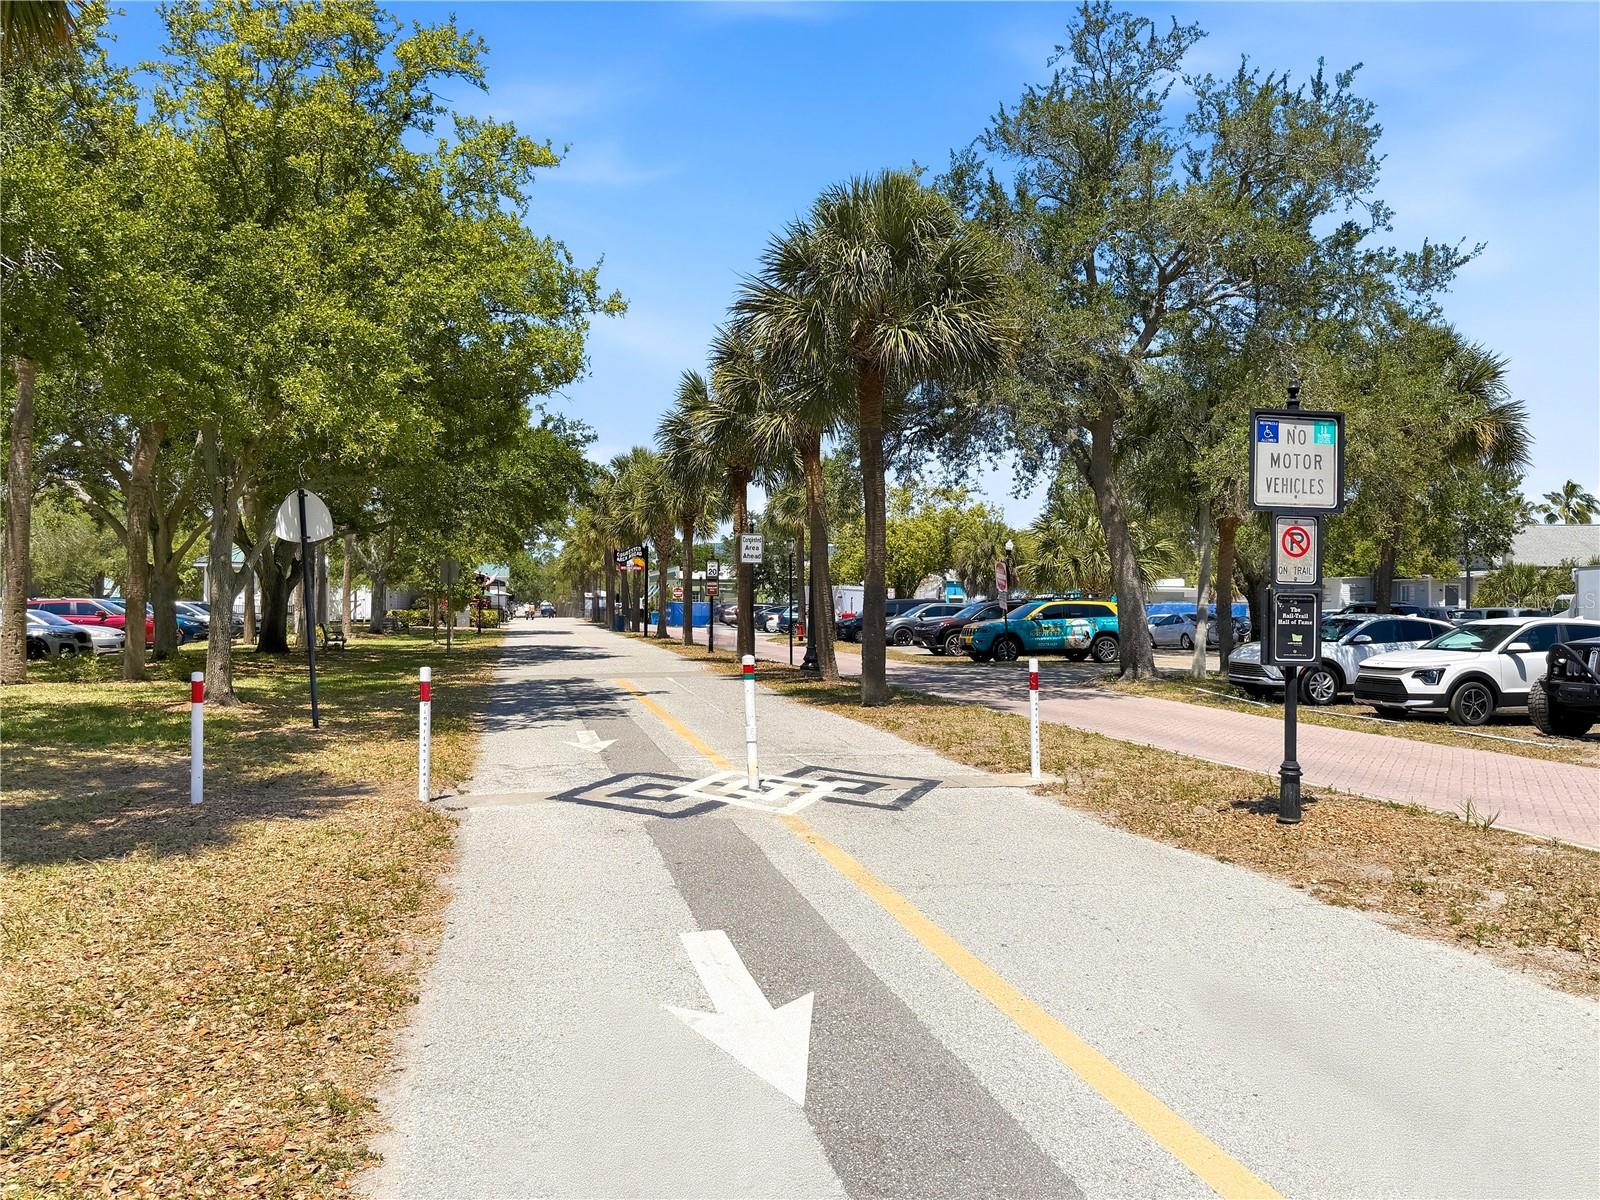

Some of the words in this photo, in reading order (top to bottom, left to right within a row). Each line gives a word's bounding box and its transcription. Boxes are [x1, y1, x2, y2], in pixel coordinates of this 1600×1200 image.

[1287, 429, 1306, 445] NO
[1270, 452, 1323, 470] MOTOR
[1266, 477, 1324, 494] VEHICLES
[708, 568, 717, 576] 20
[1278, 566, 1288, 575] ON
[1293, 566, 1313, 576] TRAIL
